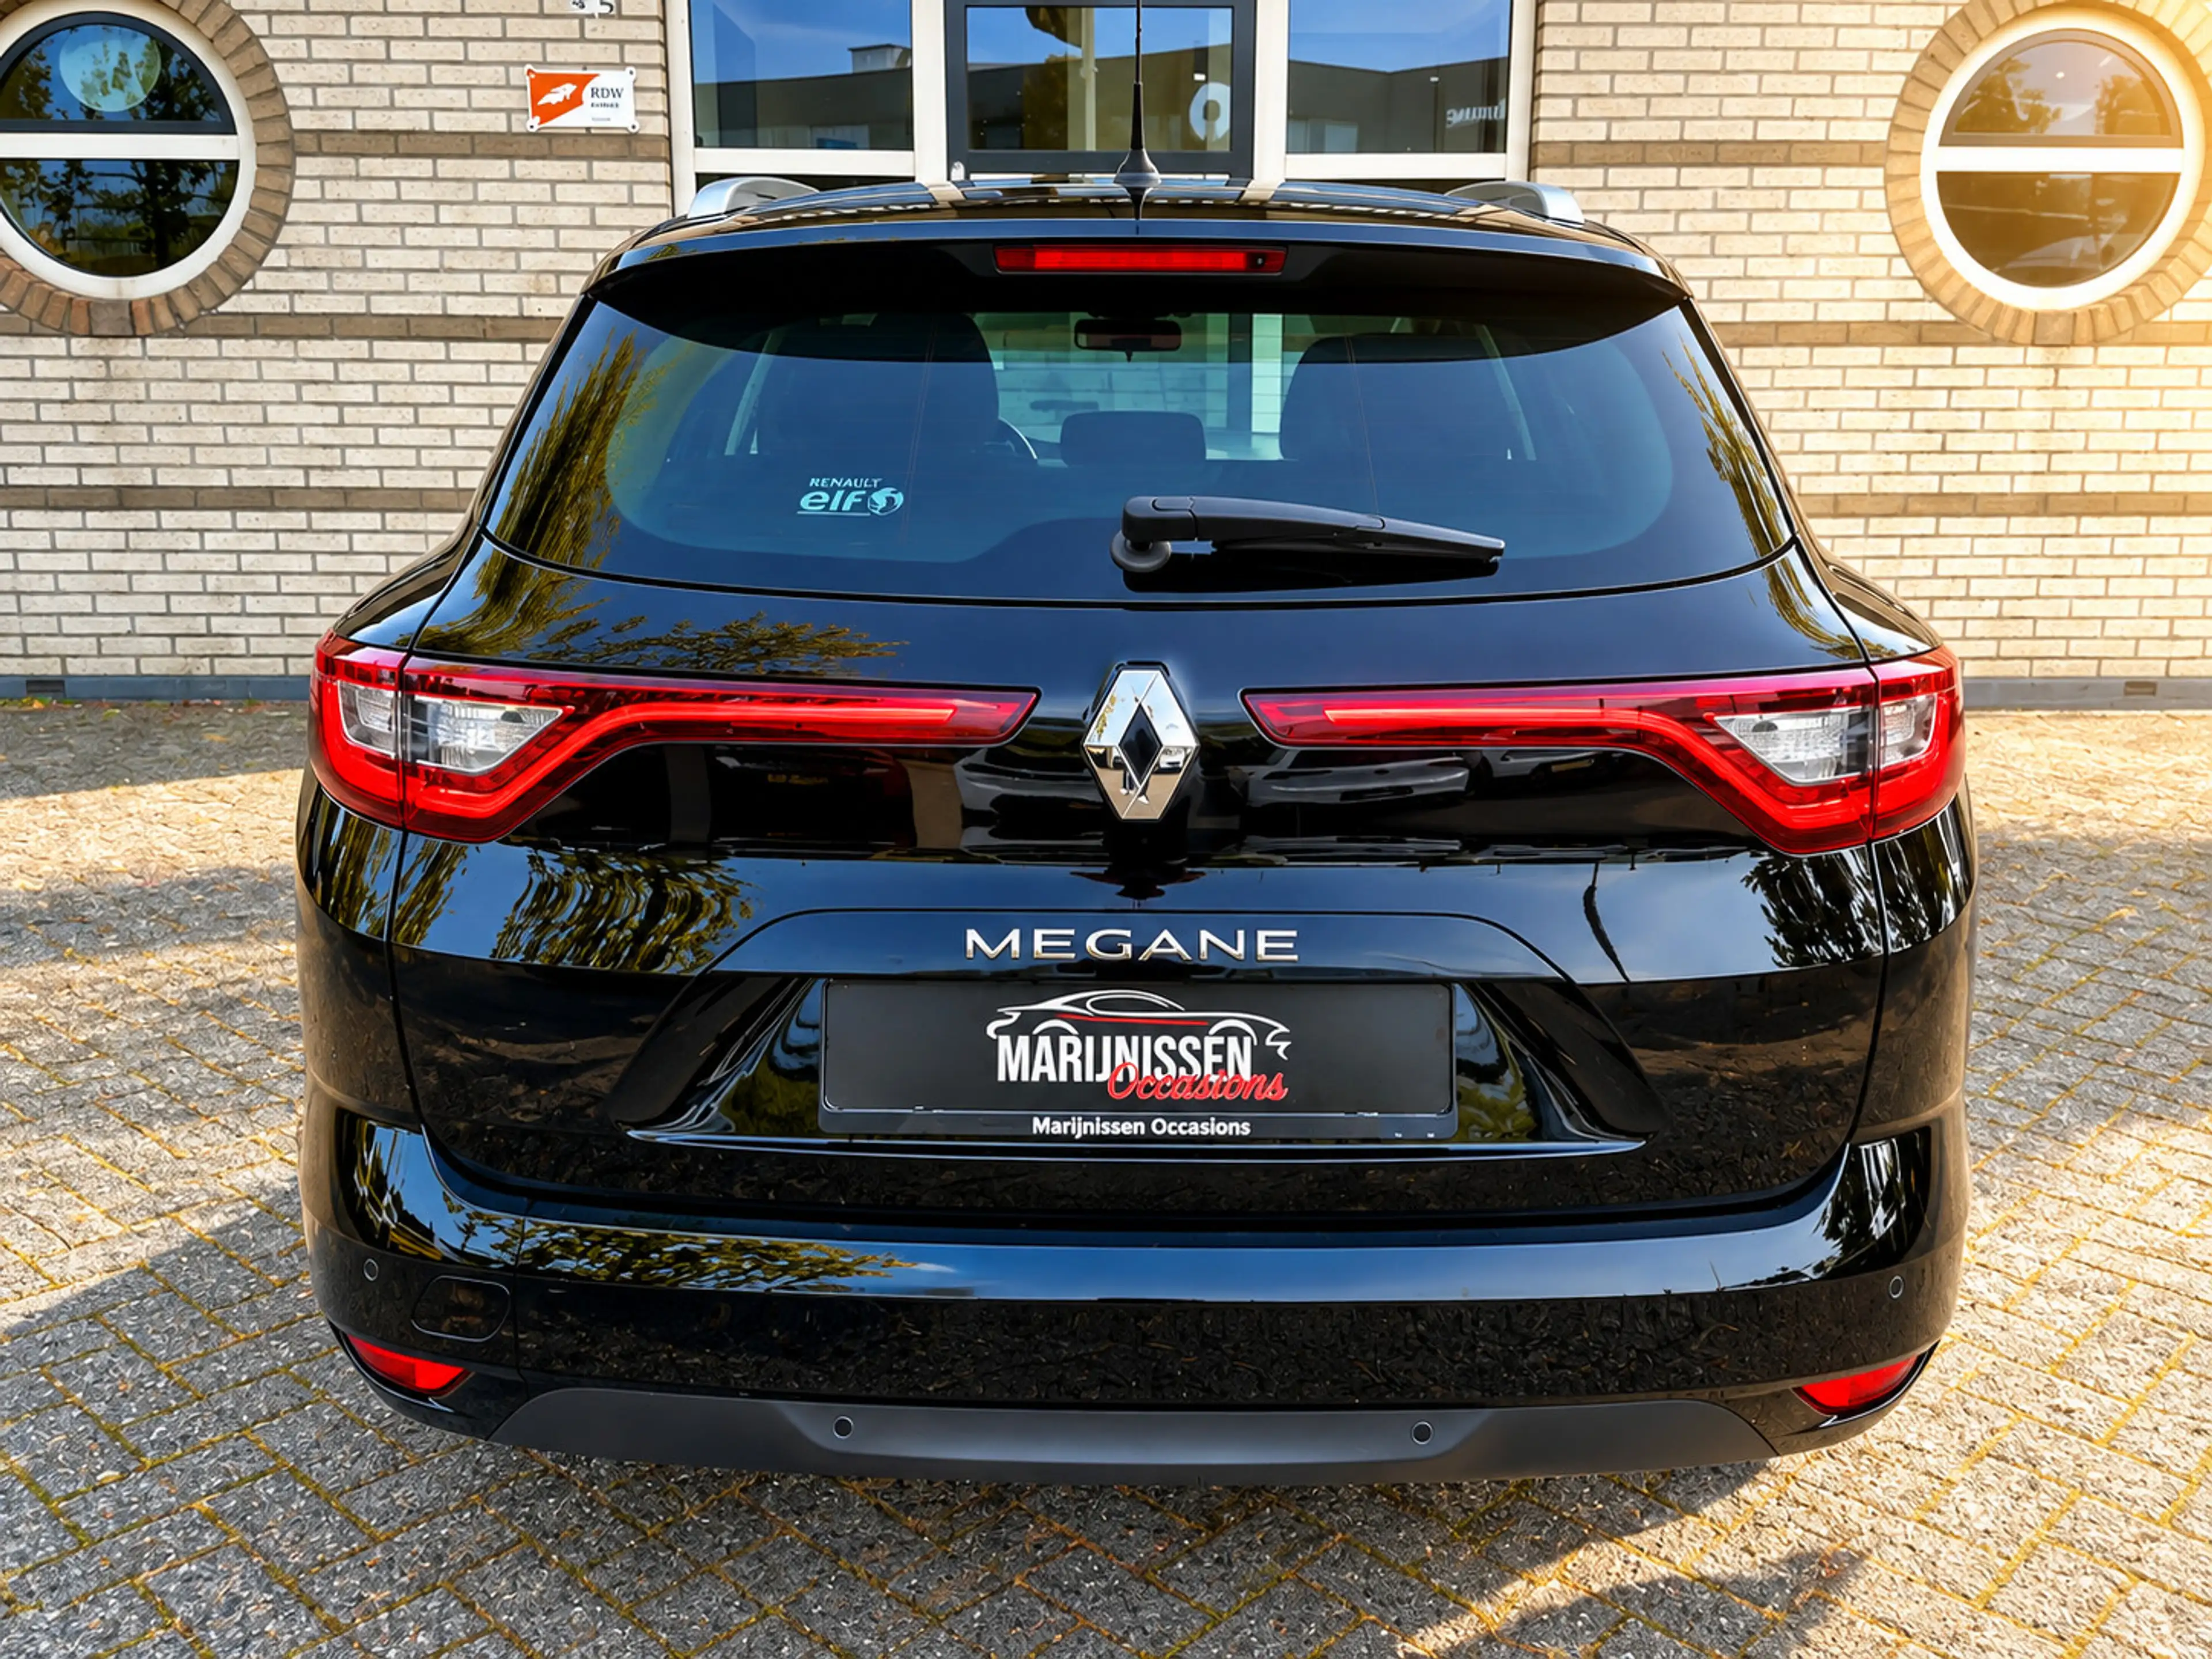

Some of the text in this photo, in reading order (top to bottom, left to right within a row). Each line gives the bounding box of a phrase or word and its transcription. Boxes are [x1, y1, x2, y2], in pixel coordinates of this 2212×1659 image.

[590, 87, 624, 99] RDW
[809, 478, 882, 488] RENAULT
[800, 490, 866, 512] elf
[965, 928, 1299, 961] MEGANE
[997, 1035, 1252, 1082] MARIJNISSEN
[1107, 1062, 1289, 1101] Occasions
[1033, 1116, 1251, 1139] Marijnissen Occasions
